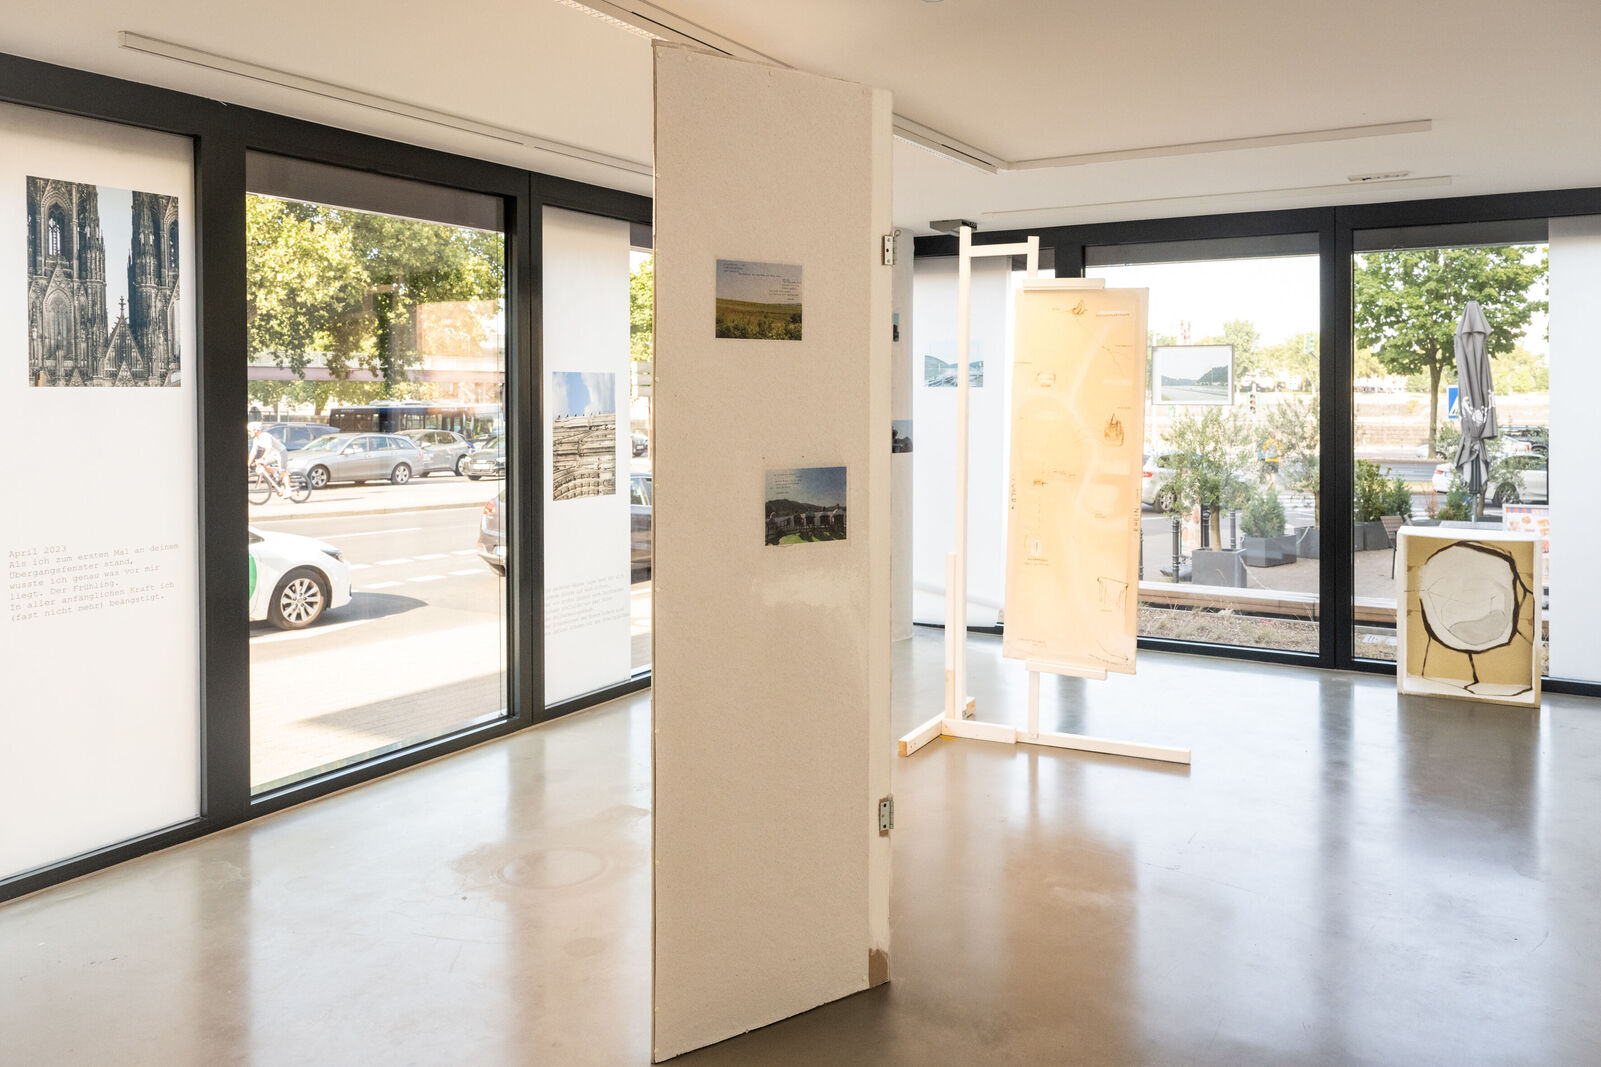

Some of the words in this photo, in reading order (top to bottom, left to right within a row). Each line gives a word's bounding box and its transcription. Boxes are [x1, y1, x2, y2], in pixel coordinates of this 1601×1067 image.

[8, 547, 37, 559] April
[43, 545, 66, 555] 2023
[9, 560, 26, 569] Als
[33, 557, 50, 566] ich
[77, 552, 109, 561] ersten
[113, 547, 129, 557] Mal
[149, 543, 179, 552] deinem
[103, 558, 133, 568] stand,
[9, 579, 44, 590] wusste
[50, 576, 67, 585] ich
[72, 573, 100, 584] genau
[103, 570, 120, 578] was
[124, 567, 141, 575] vor
[144, 564, 161, 573] mir
[10, 591, 44, 601] liegt.
[50, 587, 67, 595] Der
[10, 603, 22, 611] In
[27, 598, 56, 609] aller
[129, 584, 156, 594] Kraft
[160, 581, 175, 590] ich
[11, 612, 39, 623] (fast
[44, 606, 73, 617] nicht
